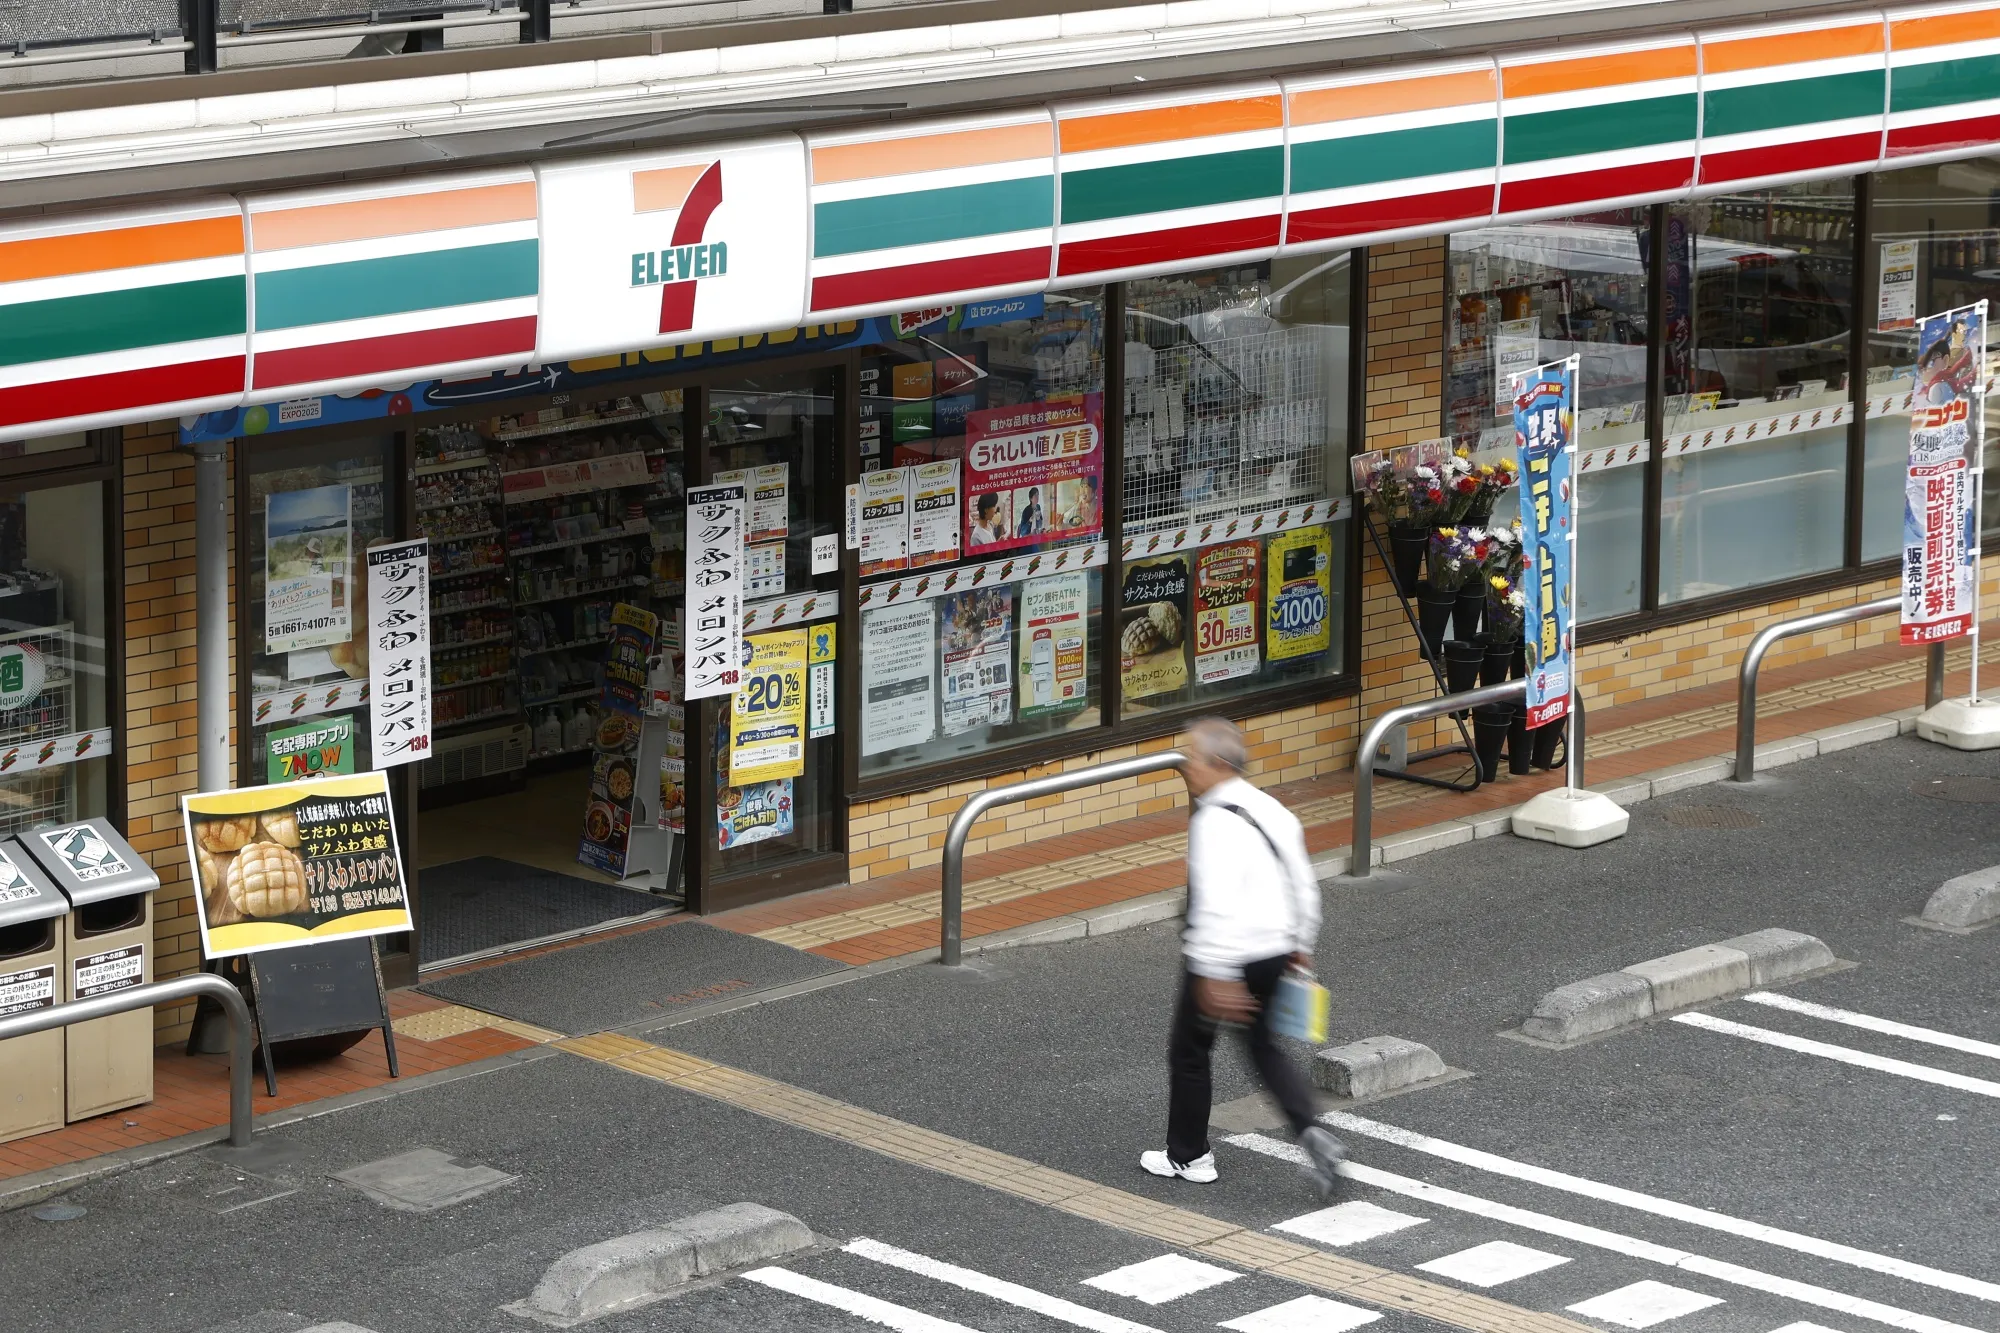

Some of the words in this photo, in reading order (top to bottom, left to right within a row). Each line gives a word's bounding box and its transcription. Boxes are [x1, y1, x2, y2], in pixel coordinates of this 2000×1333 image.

[633, 159, 722, 334] 7
[944, 369, 967, 379] チケット
[901, 416, 924, 427] プリント
[1925, 400, 1967, 428] コナン
[693, 490, 738, 504] リニューアル
[755, 488, 784, 500] スタッフ募集
[916, 495, 954, 509] スタッフ募集
[864, 504, 902, 518] スタッフ募集
[1956, 471, 1965, 566] 店内マルチコピー機にて
[814, 543, 837, 554] インボイス
[1925, 475, 1945, 617] 映画前売券
[1945, 473, 1956, 612] コンテンツプリント付き
[375, 545, 421, 565] リニューアル
[817, 551, 833, 561] 対象店
[1136, 568, 1176, 582] こだわり抜いた
[1027, 587, 1081, 606] セブン銀行ATMで
[1124, 578, 1185, 603] サクふわ食感
[1198, 578, 1256, 599] レシートクーポン
[1207, 591, 1246, 607] プレゼント！
[1032, 600, 1075, 617] ゆうちょご利用
[1282, 594, 1324, 629] 1,000
[268, 617, 336, 636] 5億1661万4107円
[1199, 619, 1253, 650] 30円引き
[621, 645, 636, 663] 世界
[761, 639, 804, 651] VポイントPayアプリ
[721, 670, 740, 686] 138
[1124, 666, 1183, 687] サクふわメロンパン
[0, 693, 25, 707] iquor
[783, 694, 799, 707] 還元
[271, 724, 350, 755] 宅配専用アプリ
[409, 734, 428, 752] 138
[668, 735, 684, 745] ご予約
[280, 744, 341, 777] 7NOW
[662, 760, 685, 770] ご予約弁
[296, 796, 388, 825] 大人気商品が美味しくなって新登場！
[747, 799, 763, 813] 世界
[299, 817, 390, 840] こだわりぬいた
[734, 810, 776, 831] ごはん万博
[307, 834, 388, 857] サクふわ食感
[305, 851, 397, 895] サクふわメロンパン
[89, 949, 129, 965] お客様へのお願い
[79, 958, 138, 978] 家庭ゴミの持ち込みは
[0, 980, 49, 996] ゴミの持ち込みは
